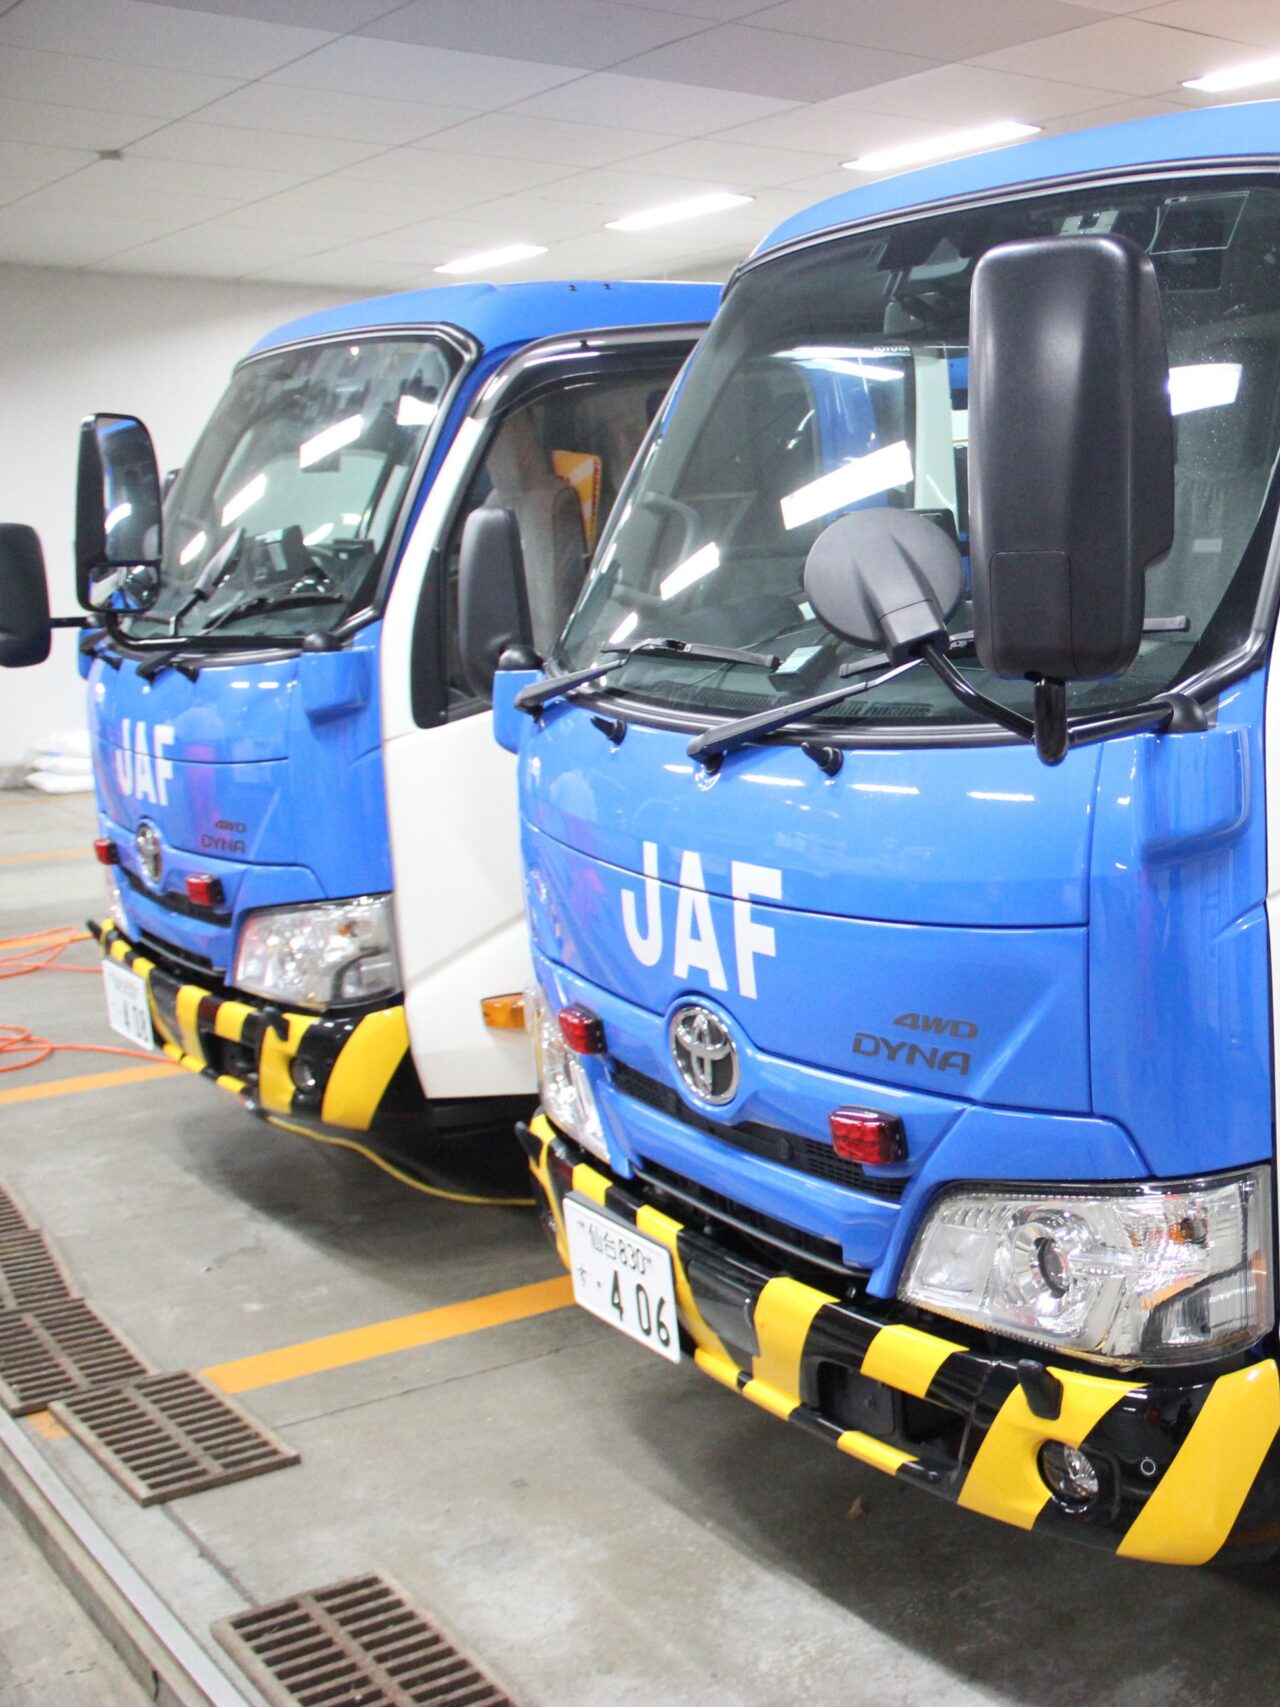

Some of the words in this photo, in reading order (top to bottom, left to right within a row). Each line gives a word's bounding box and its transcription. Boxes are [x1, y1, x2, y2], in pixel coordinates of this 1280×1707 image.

[114, 718, 176, 807] JAF
[201, 833, 247, 854] DYNA
[620, 841, 783, 1001] JAF
[893, 1012, 979, 1039] 4WD
[851, 1031, 972, 1077] DYNA
